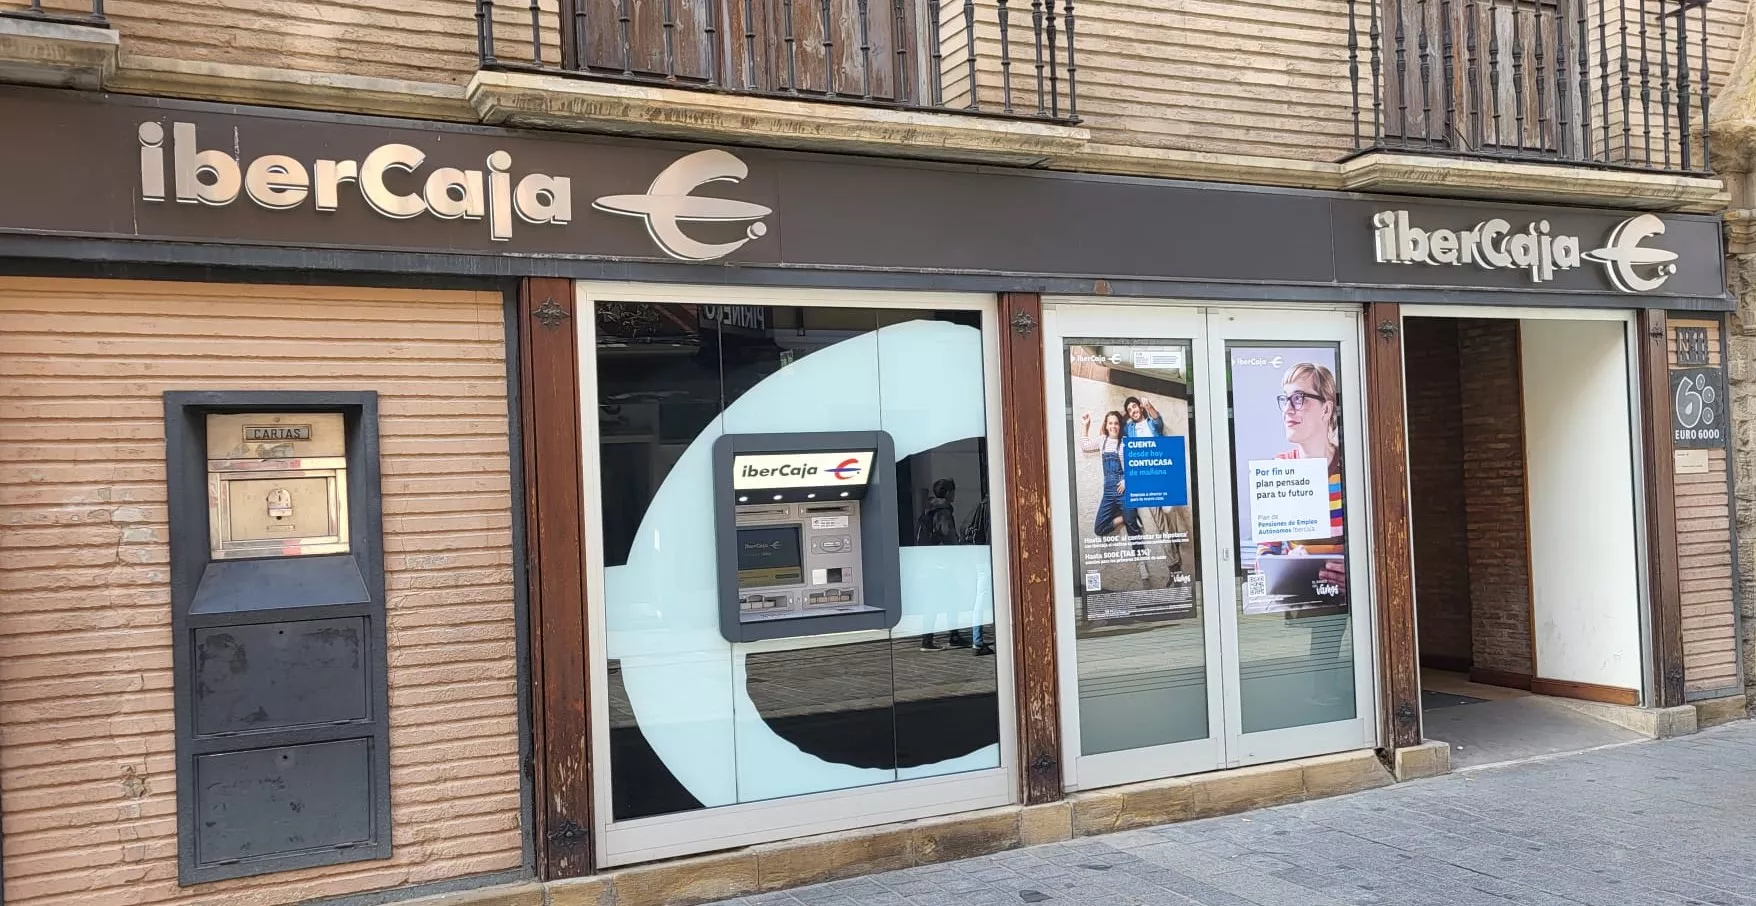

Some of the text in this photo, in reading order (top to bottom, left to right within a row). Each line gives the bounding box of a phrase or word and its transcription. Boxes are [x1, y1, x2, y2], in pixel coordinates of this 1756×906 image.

[138, 121, 572, 241] iberCaja
[1374, 210, 1581, 282] iberCaja
[253, 428, 301, 439] CARTAS
[1675, 429, 1720, 440] EURO 6000
[1127, 440, 1157, 449] CUENTA
[1128, 449, 1164, 458] desde hoy
[1128, 458, 1173, 467] CONTUCASA
[741, 463, 818, 479] iberCaja
[1129, 468, 1138, 476] de
[1255, 468, 1270, 476] Por
[1272, 467, 1283, 476] fin
[1256, 477, 1310, 489] plan pensado
[1256, 489, 1314, 500] para tu futuro
[1258, 520, 1287, 528] Pensiones
[1296, 519, 1318, 527] Empleo
